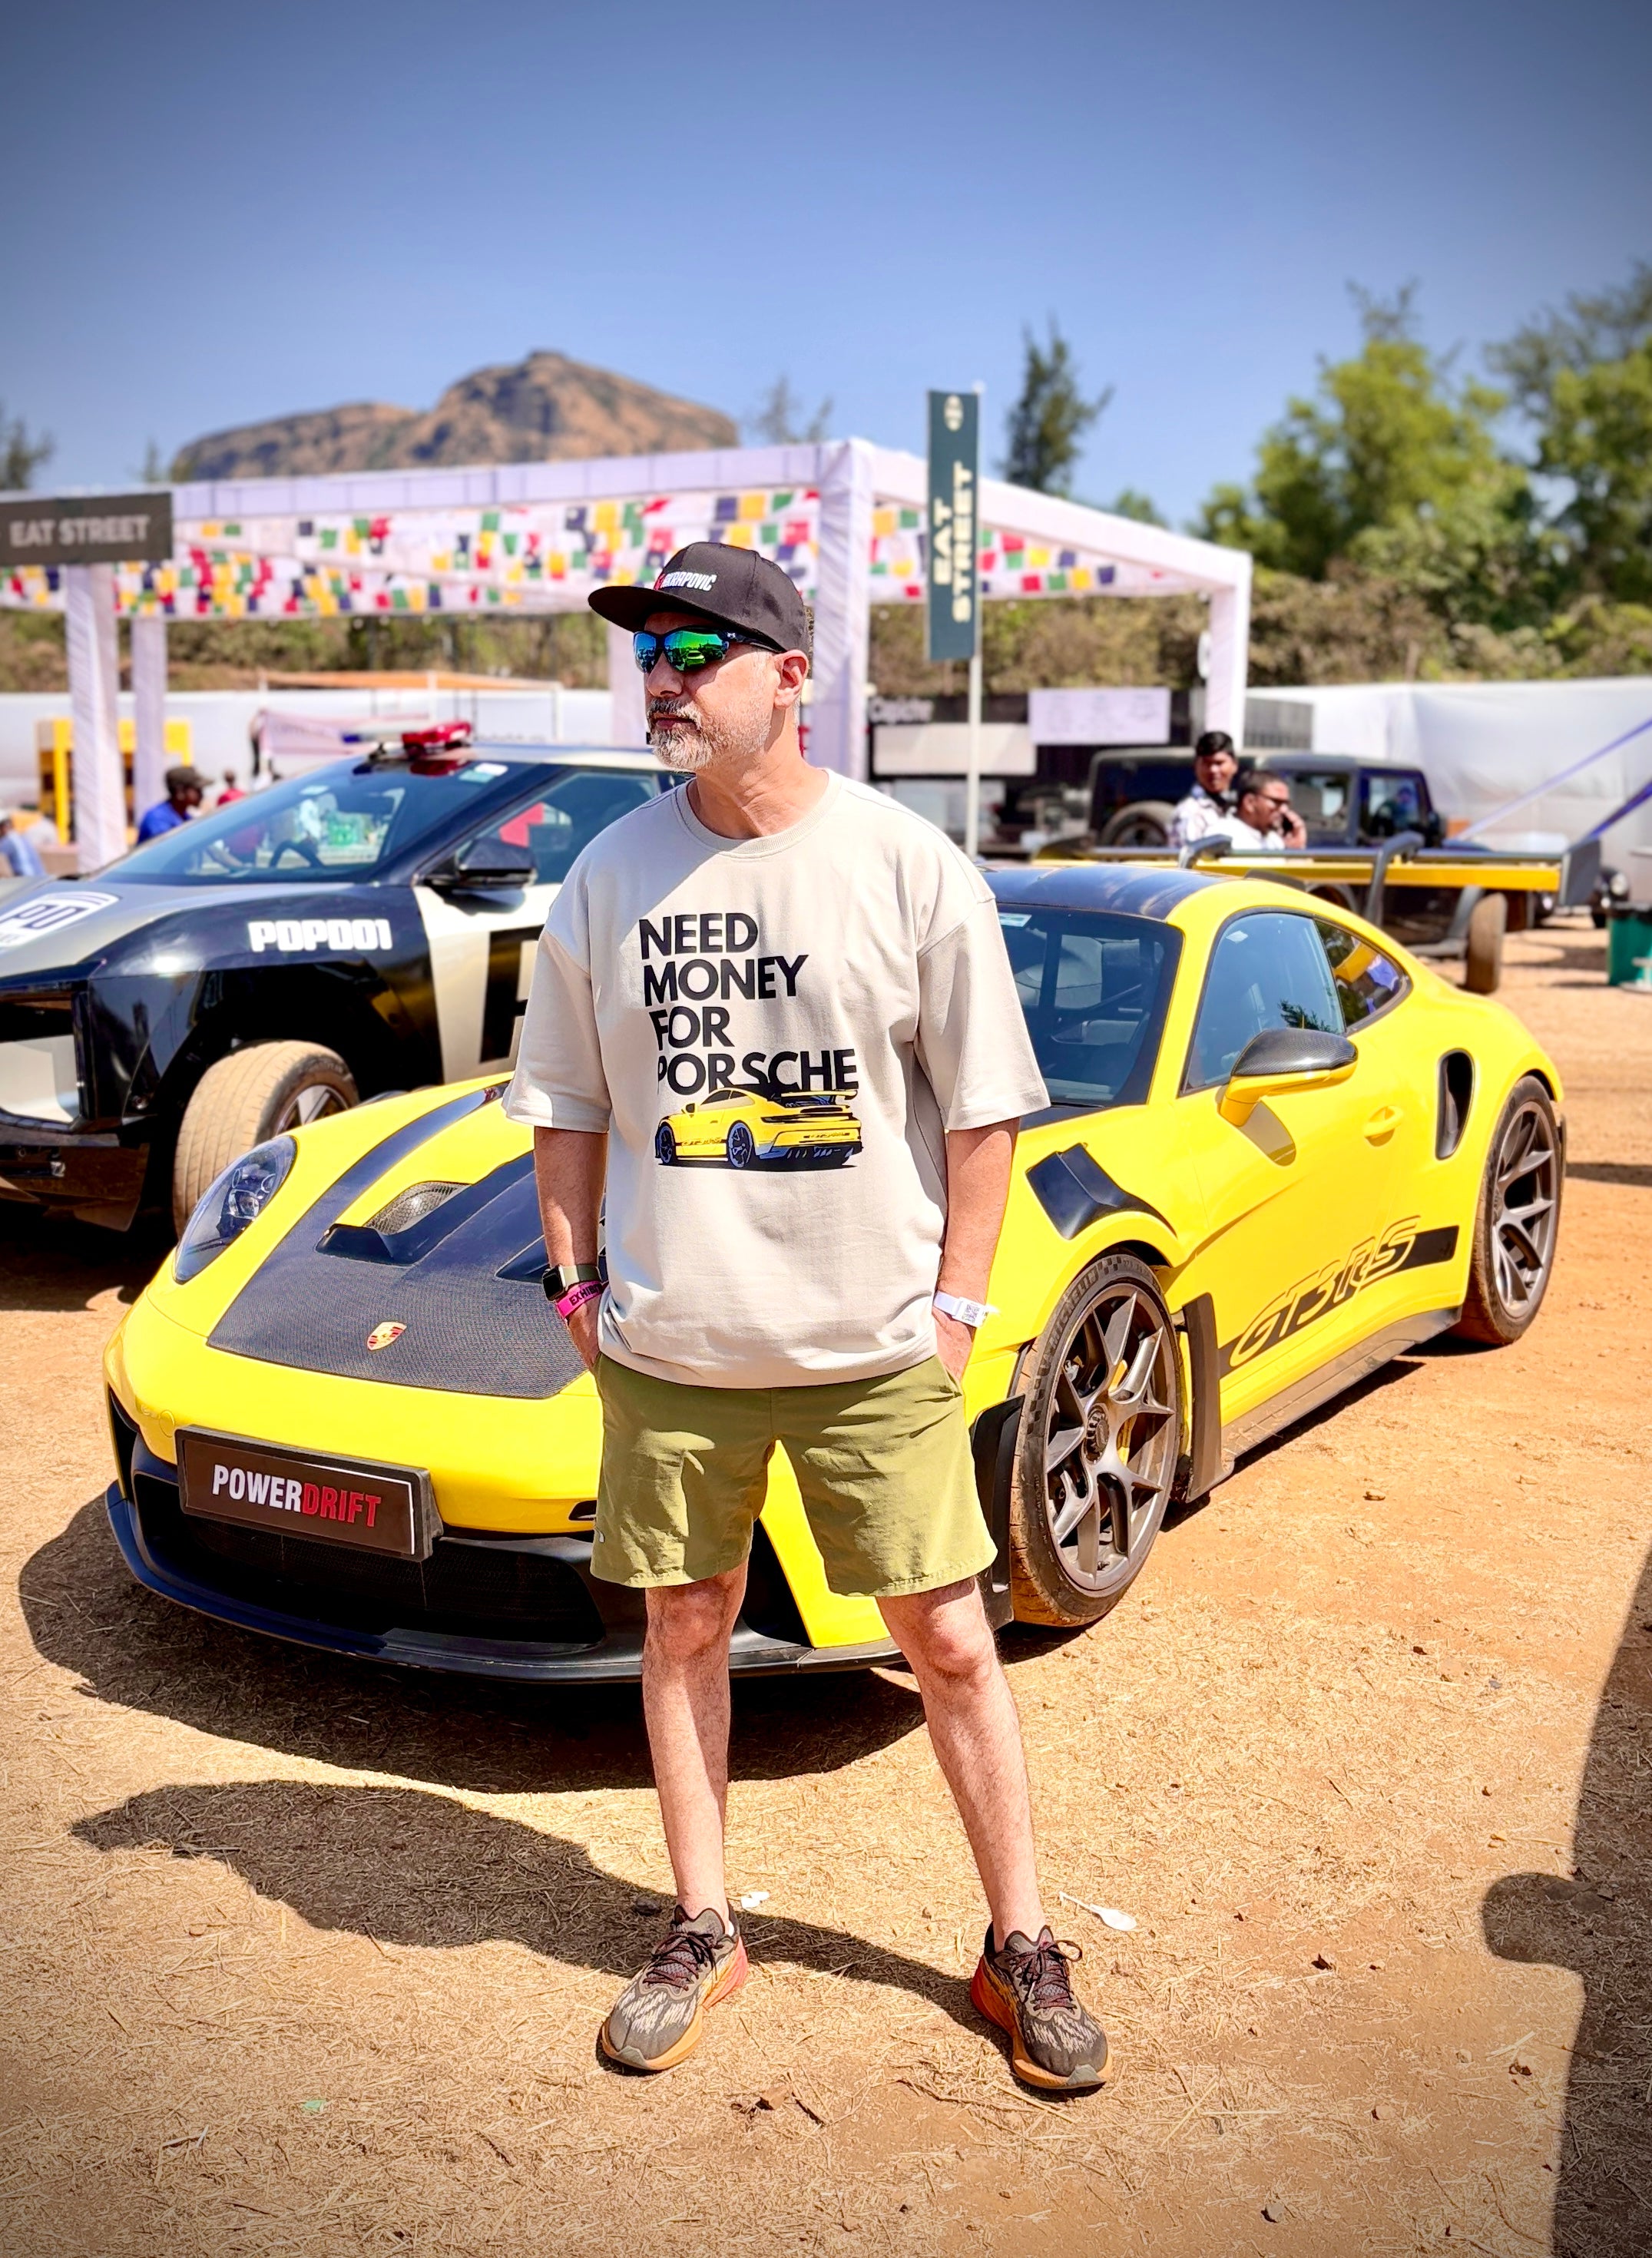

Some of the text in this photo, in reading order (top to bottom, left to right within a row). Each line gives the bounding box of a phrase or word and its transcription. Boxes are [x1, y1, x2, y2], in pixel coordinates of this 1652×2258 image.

[10, 514, 150, 547] EAT STREET
[933, 498, 952, 585] EAT
[952, 462, 973, 623] STREET
[638, 912, 759, 960] NEED
[643, 954, 809, 1007] MONEY
[648, 1005, 735, 1051] FOR
[657, 1048, 859, 1095] PORSCHE
[212, 1464, 382, 1528] POWERDRIFT
